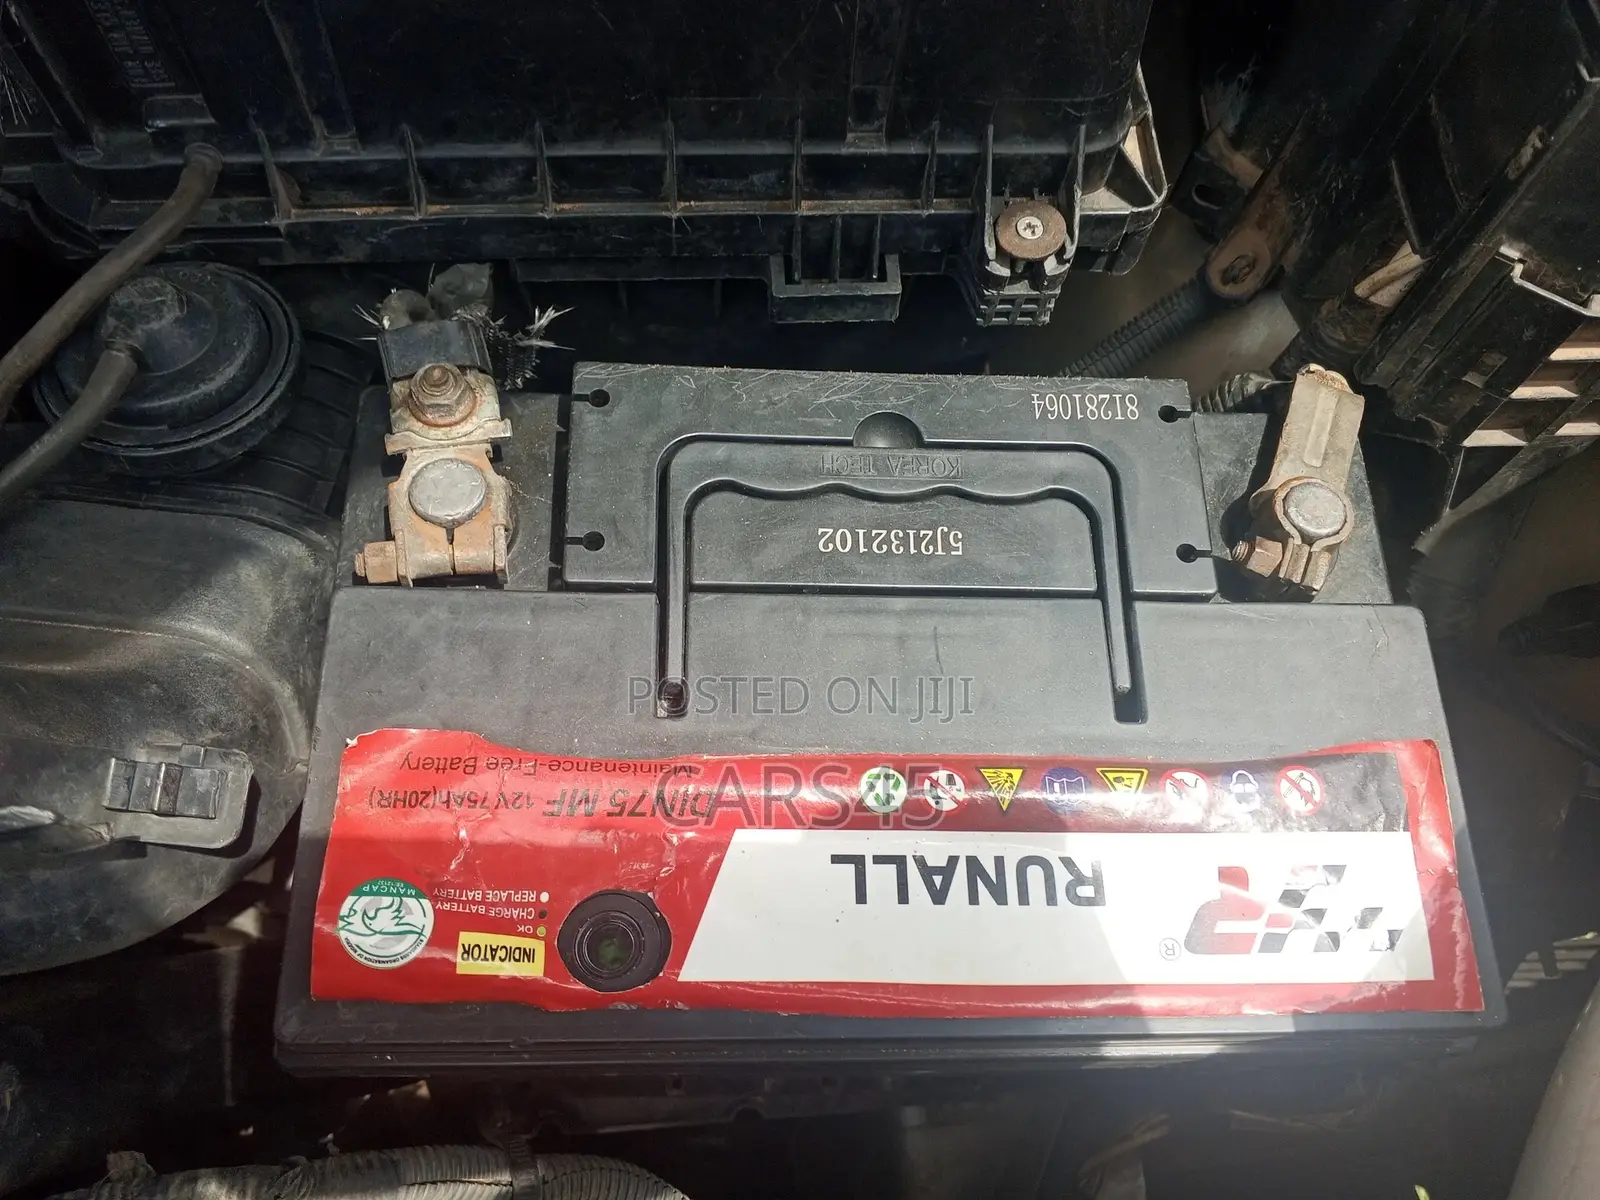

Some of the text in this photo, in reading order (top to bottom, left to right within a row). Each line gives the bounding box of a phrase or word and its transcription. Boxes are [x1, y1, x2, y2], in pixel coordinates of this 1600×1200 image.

[820, 452, 962, 477] KOREA TECH
[817, 526, 963, 555] 5J2132102
[400, 751, 478, 775] Battery
[369, 786, 717, 818] DIN75 MF 12V 75Ah(20HR)
[362, 884, 416, 896] MANCAP
[830, 854, 1107, 907] RUNALL
[433, 888, 537, 902] REPLACE BATTERY
[435, 901, 535, 920] CHARGE BATTERY
[516, 924, 534, 934] OK
[460, 943, 536, 963] INDICATOR
